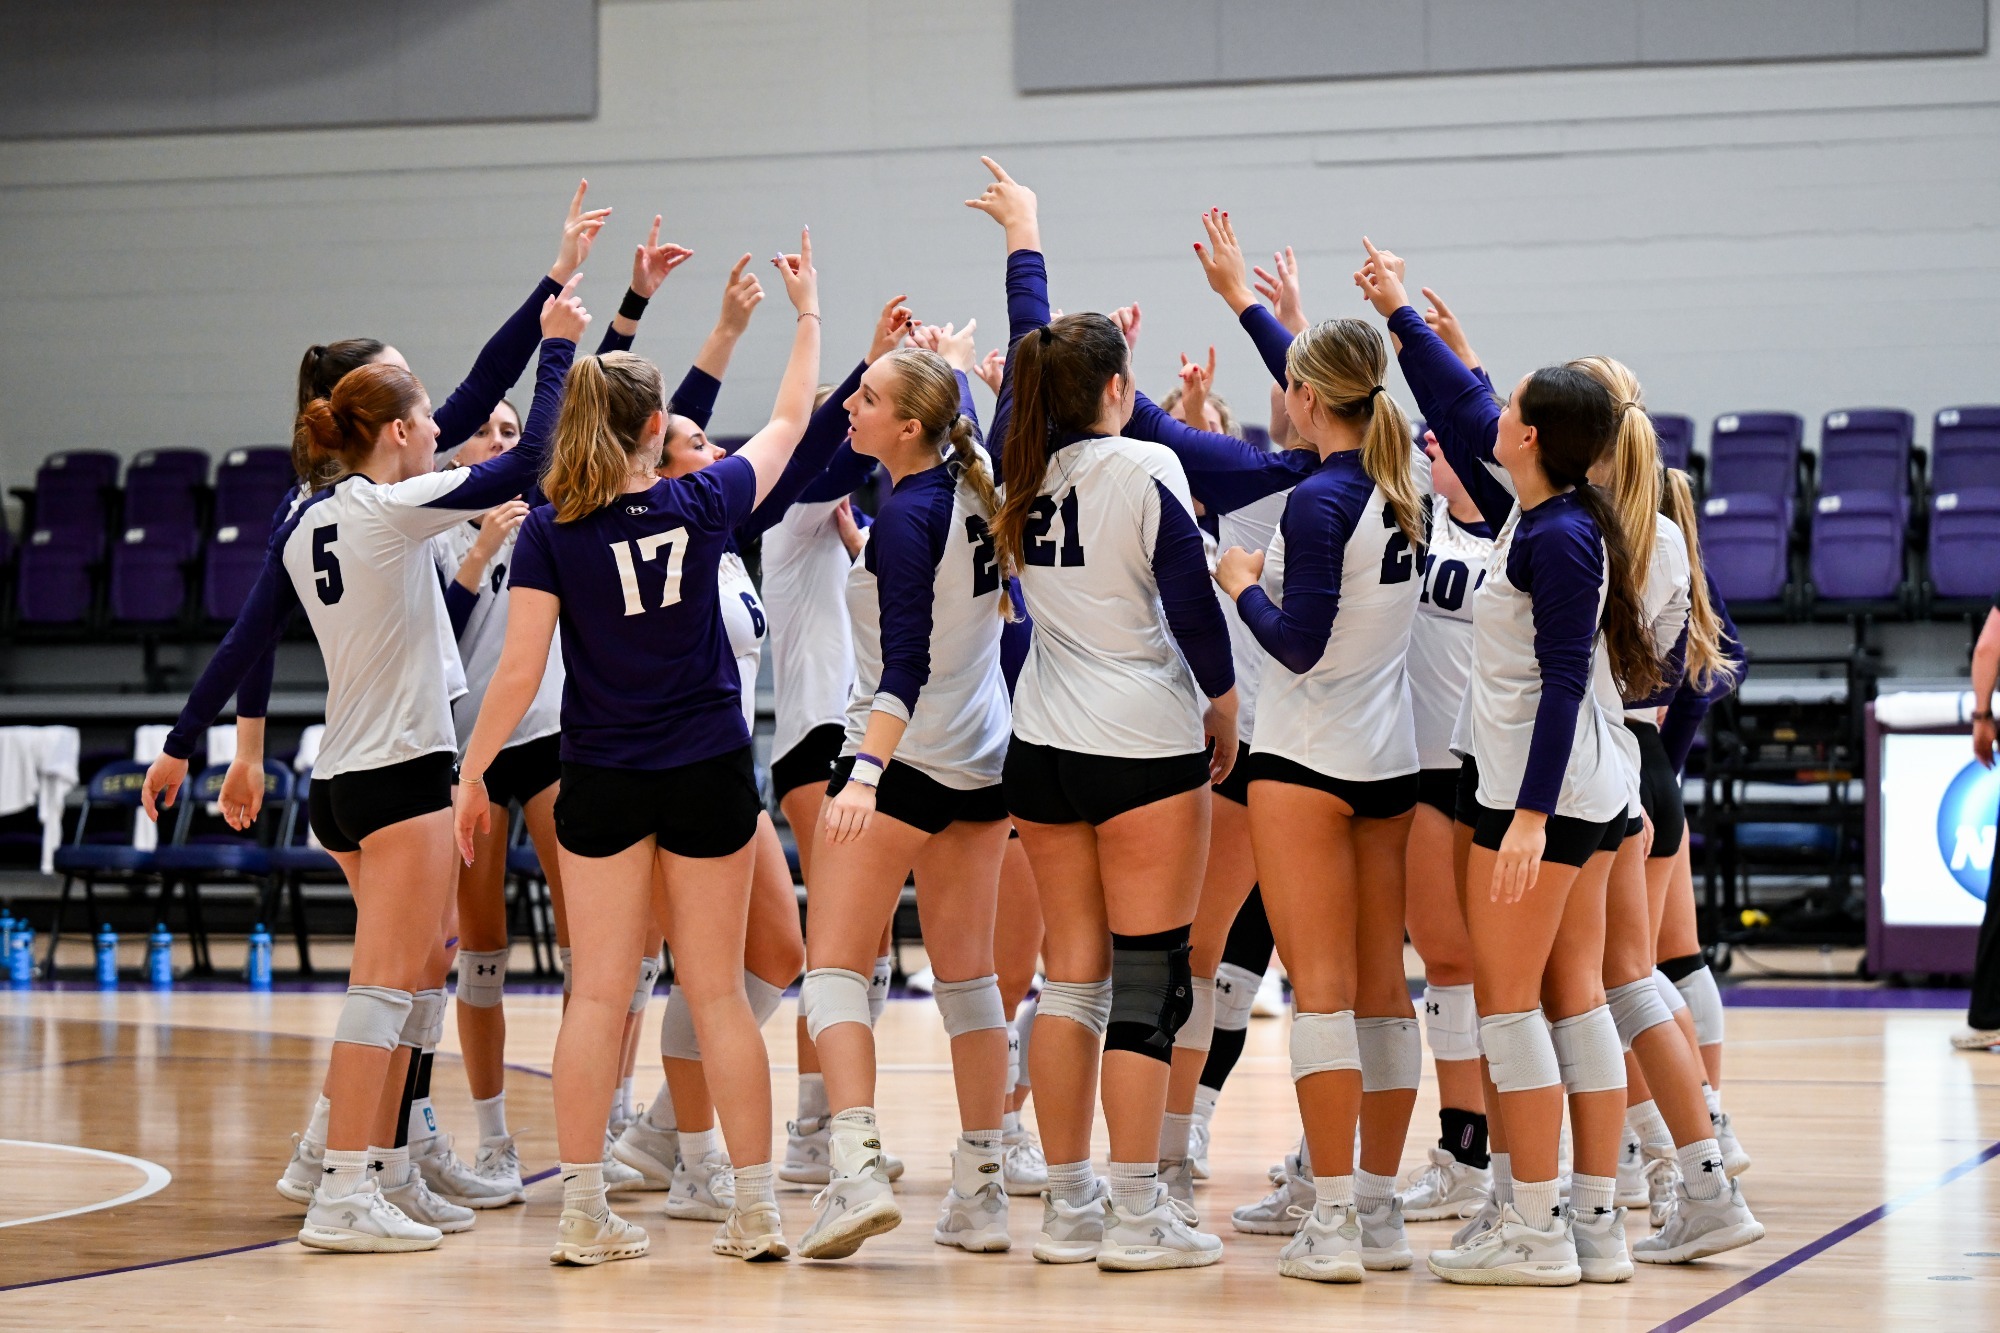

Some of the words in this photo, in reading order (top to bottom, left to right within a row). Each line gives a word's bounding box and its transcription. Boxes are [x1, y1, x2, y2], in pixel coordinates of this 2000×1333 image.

[1023, 486, 1086, 567] 21
[312, 523, 344, 606] 5
[609, 526, 689, 616] 17
[1420, 554, 1469, 611] 10
[739, 591, 766, 639] 6
[1950, 824, 1997, 870] N
